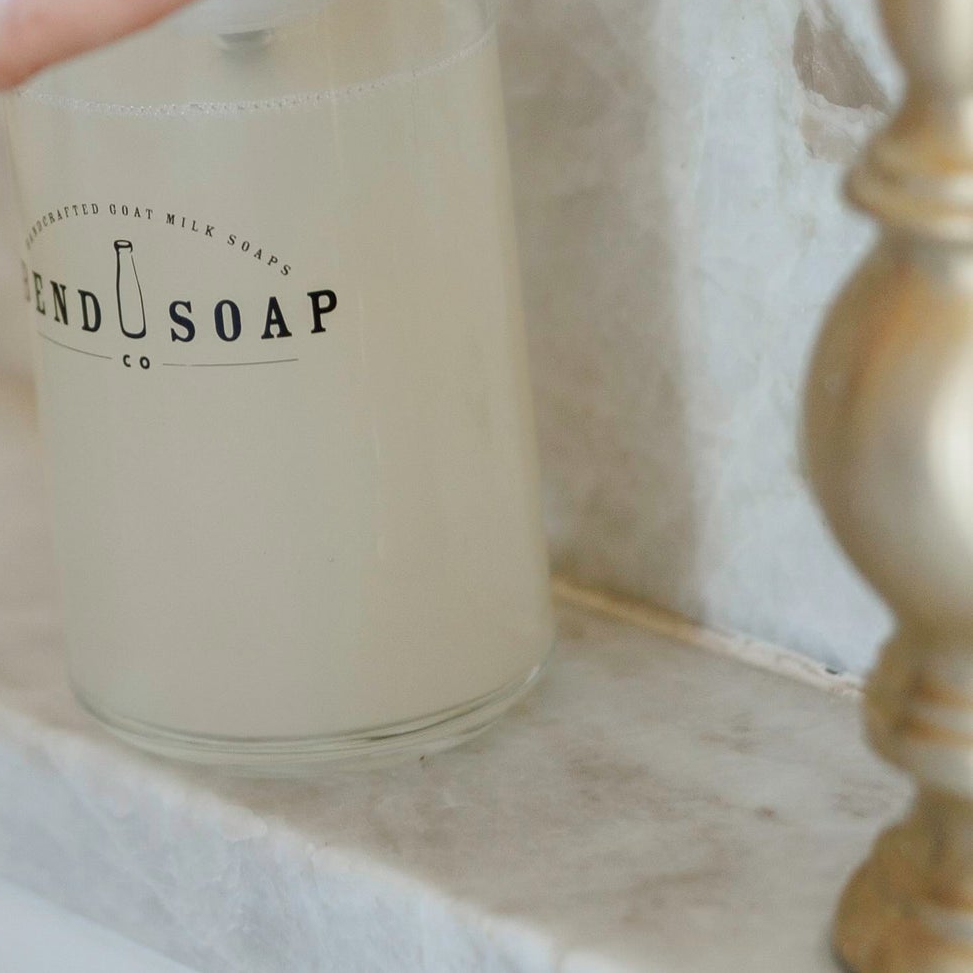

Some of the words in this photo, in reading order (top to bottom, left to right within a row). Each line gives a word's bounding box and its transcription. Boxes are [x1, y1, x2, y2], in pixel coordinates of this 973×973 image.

[109, 203, 154, 221] GOAT
[165, 213, 215, 238] MILK
[226, 233, 293, 277] SOAPS
[168, 288, 338, 343] SOAP
[122, 354, 151, 370] CO
